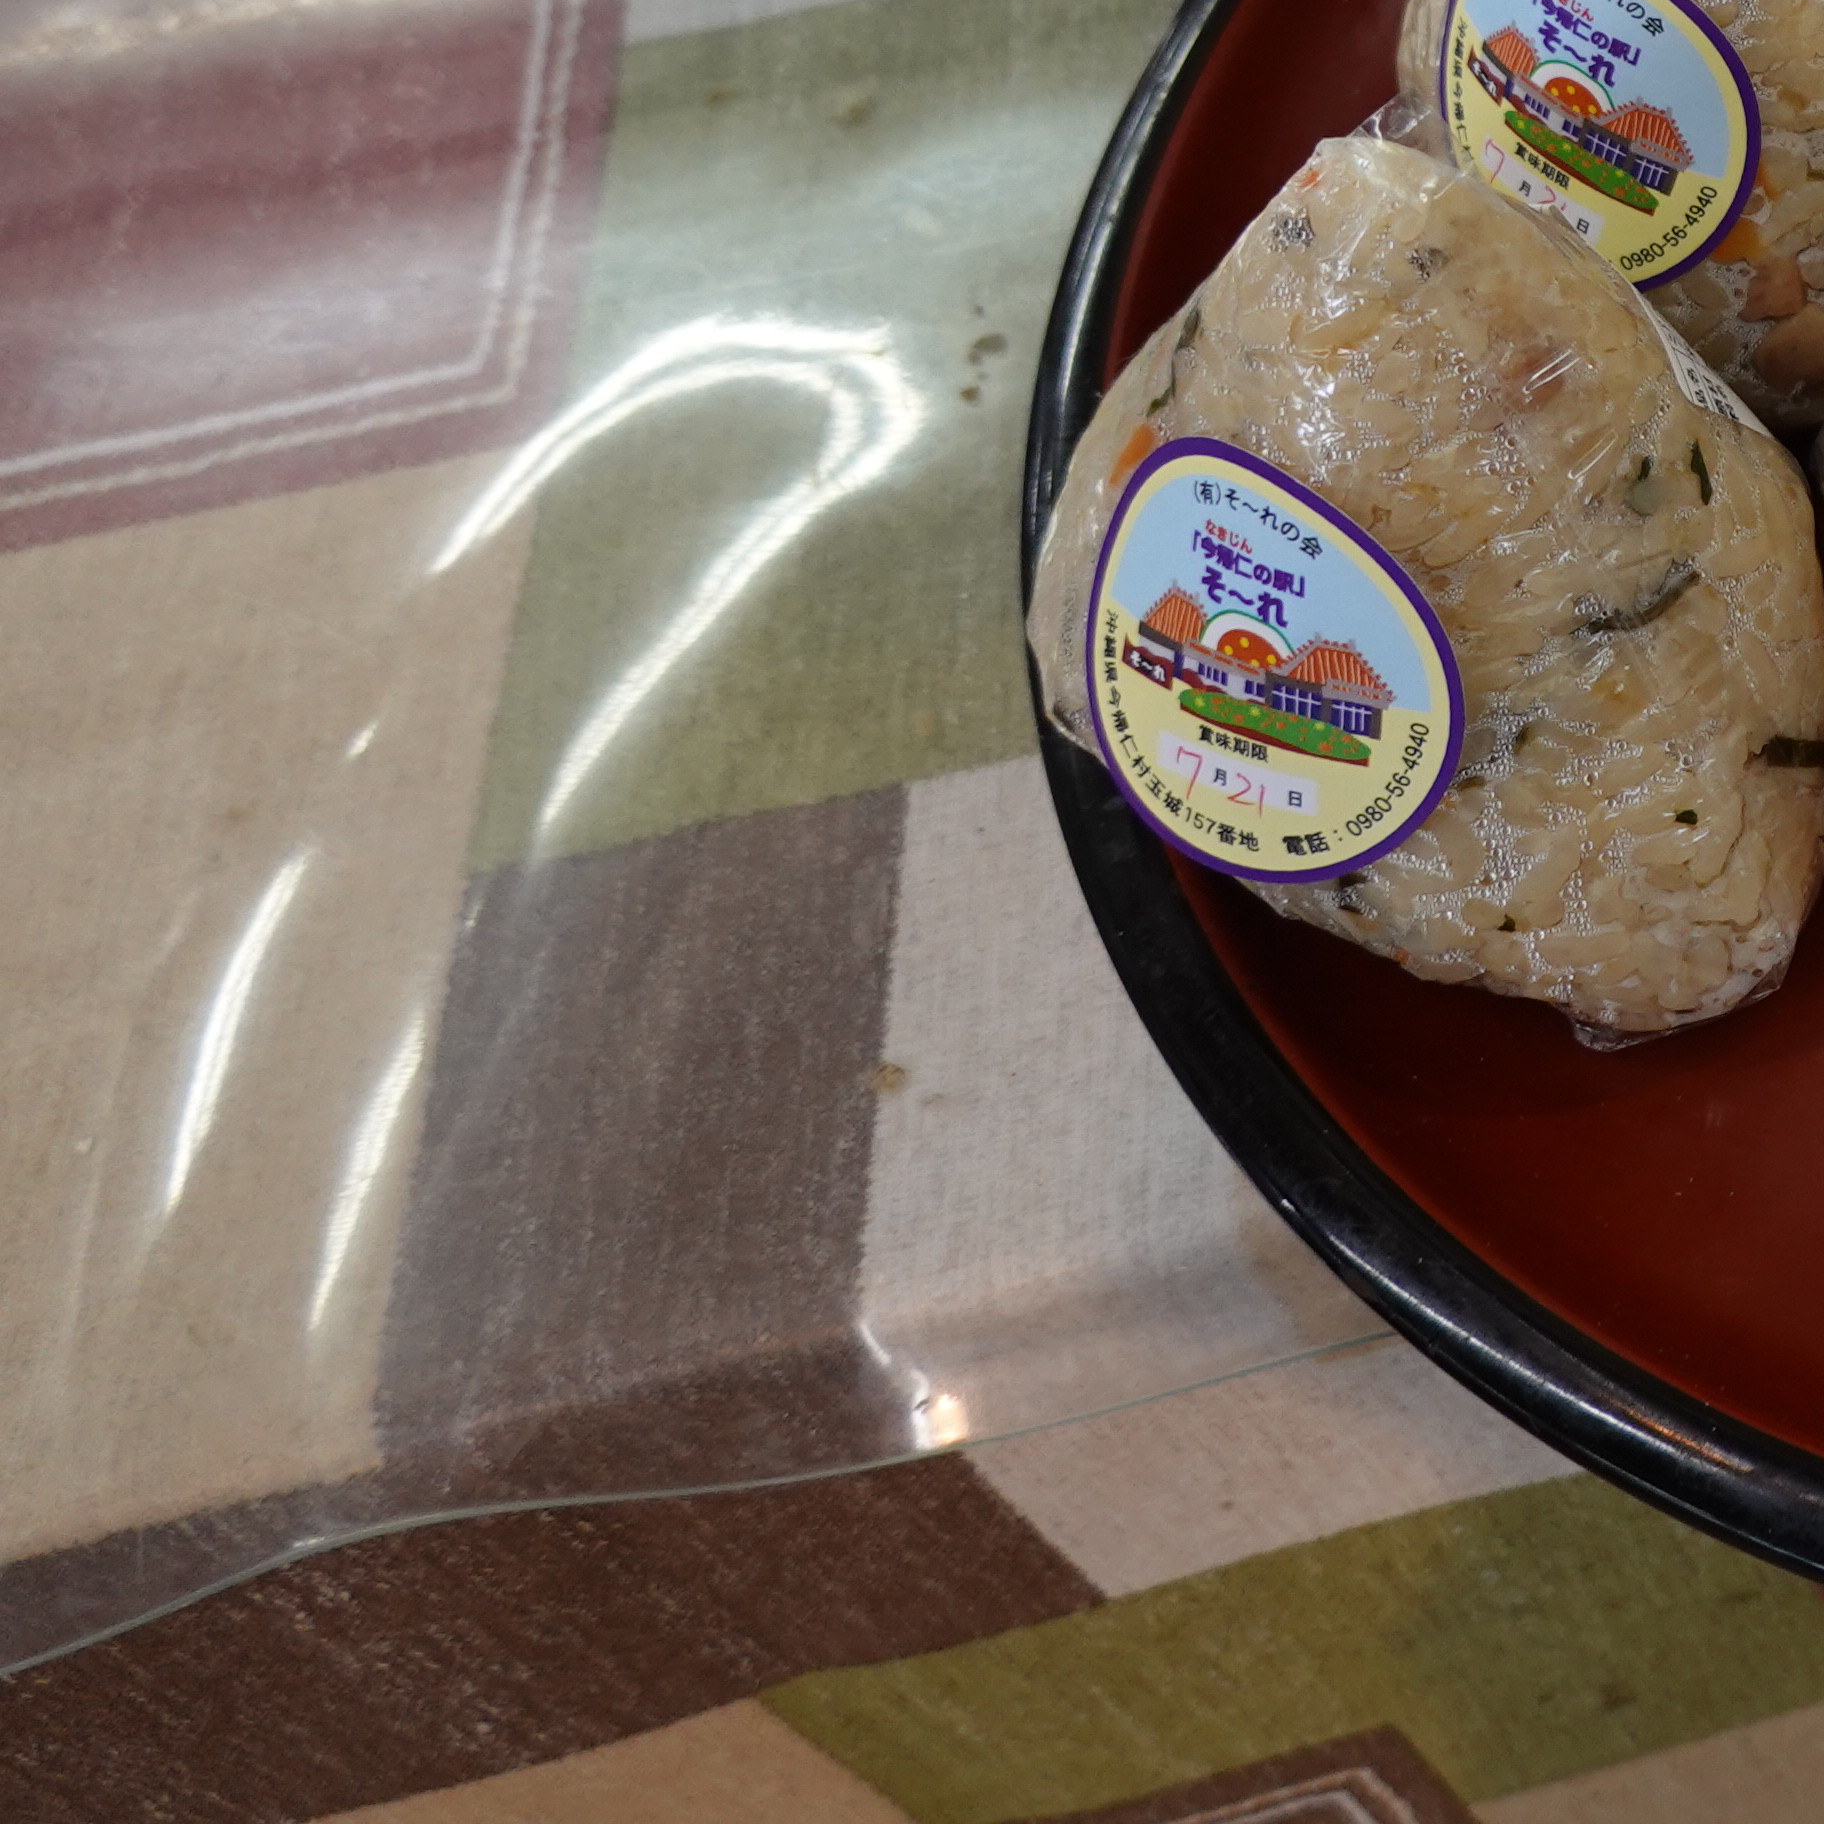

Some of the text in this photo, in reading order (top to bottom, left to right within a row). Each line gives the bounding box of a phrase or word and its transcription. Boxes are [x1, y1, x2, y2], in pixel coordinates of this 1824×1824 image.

[1619, 183, 1719, 272] 0980-56-4940
[1204, 519, 1254, 555] なきじん
[1198, 724, 1269, 763] 賞味期限
